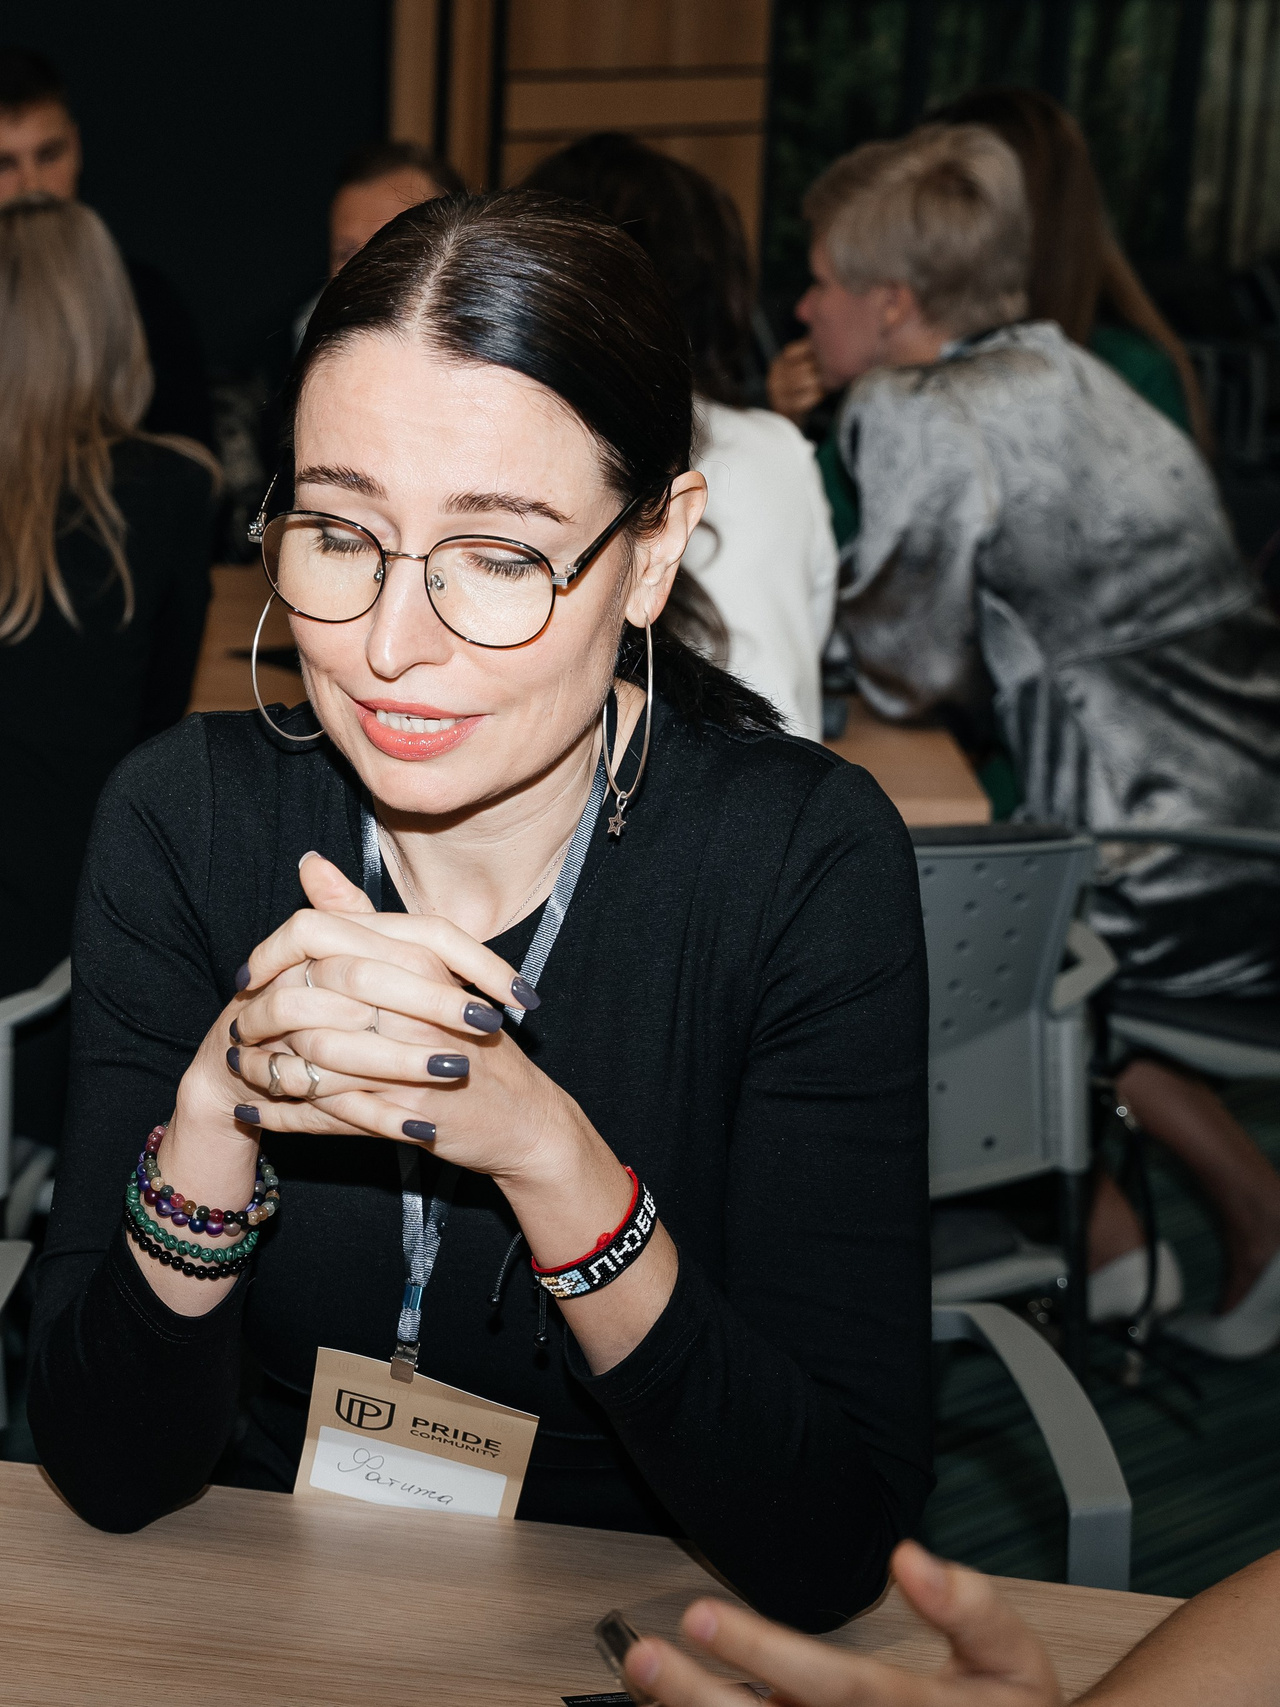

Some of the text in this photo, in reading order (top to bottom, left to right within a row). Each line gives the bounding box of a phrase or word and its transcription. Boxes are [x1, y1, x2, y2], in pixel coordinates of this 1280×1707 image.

[409, 1429, 499, 1459] COMMUNITY
[411, 1416, 502, 1453] PRIDE
[337, 1447, 455, 1507] Фатима
